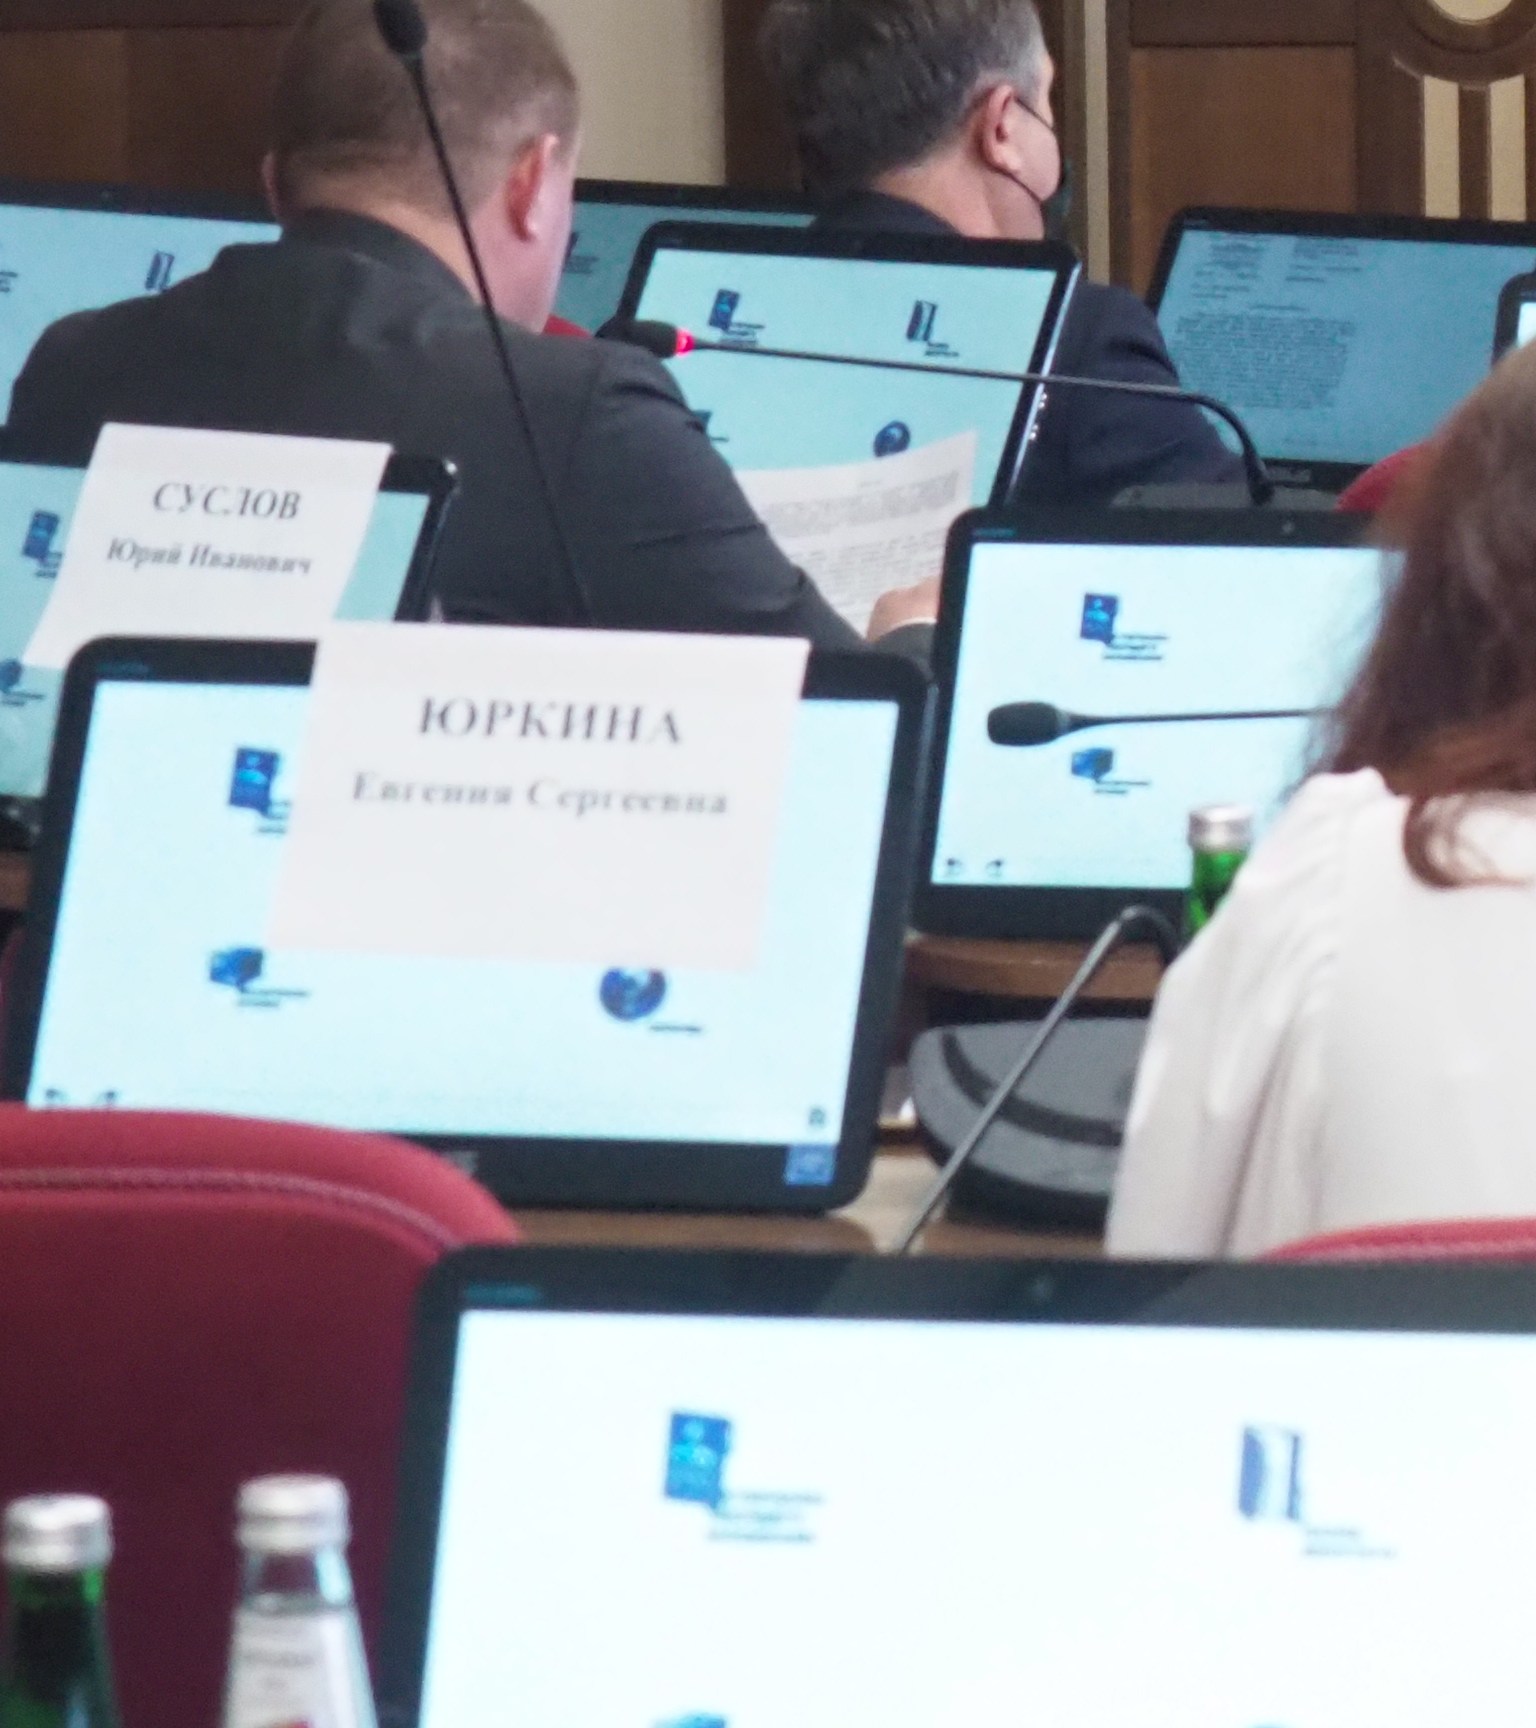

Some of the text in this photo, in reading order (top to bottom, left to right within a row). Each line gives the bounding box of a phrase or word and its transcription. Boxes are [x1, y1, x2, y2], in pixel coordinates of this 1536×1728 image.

[152, 482, 302, 520] СУСЛОВ
[105, 536, 312, 575] Юрий Иванович
[417, 696, 681, 744] ЮРКИНА
[351, 770, 729, 820] Евгения Сергеевна
